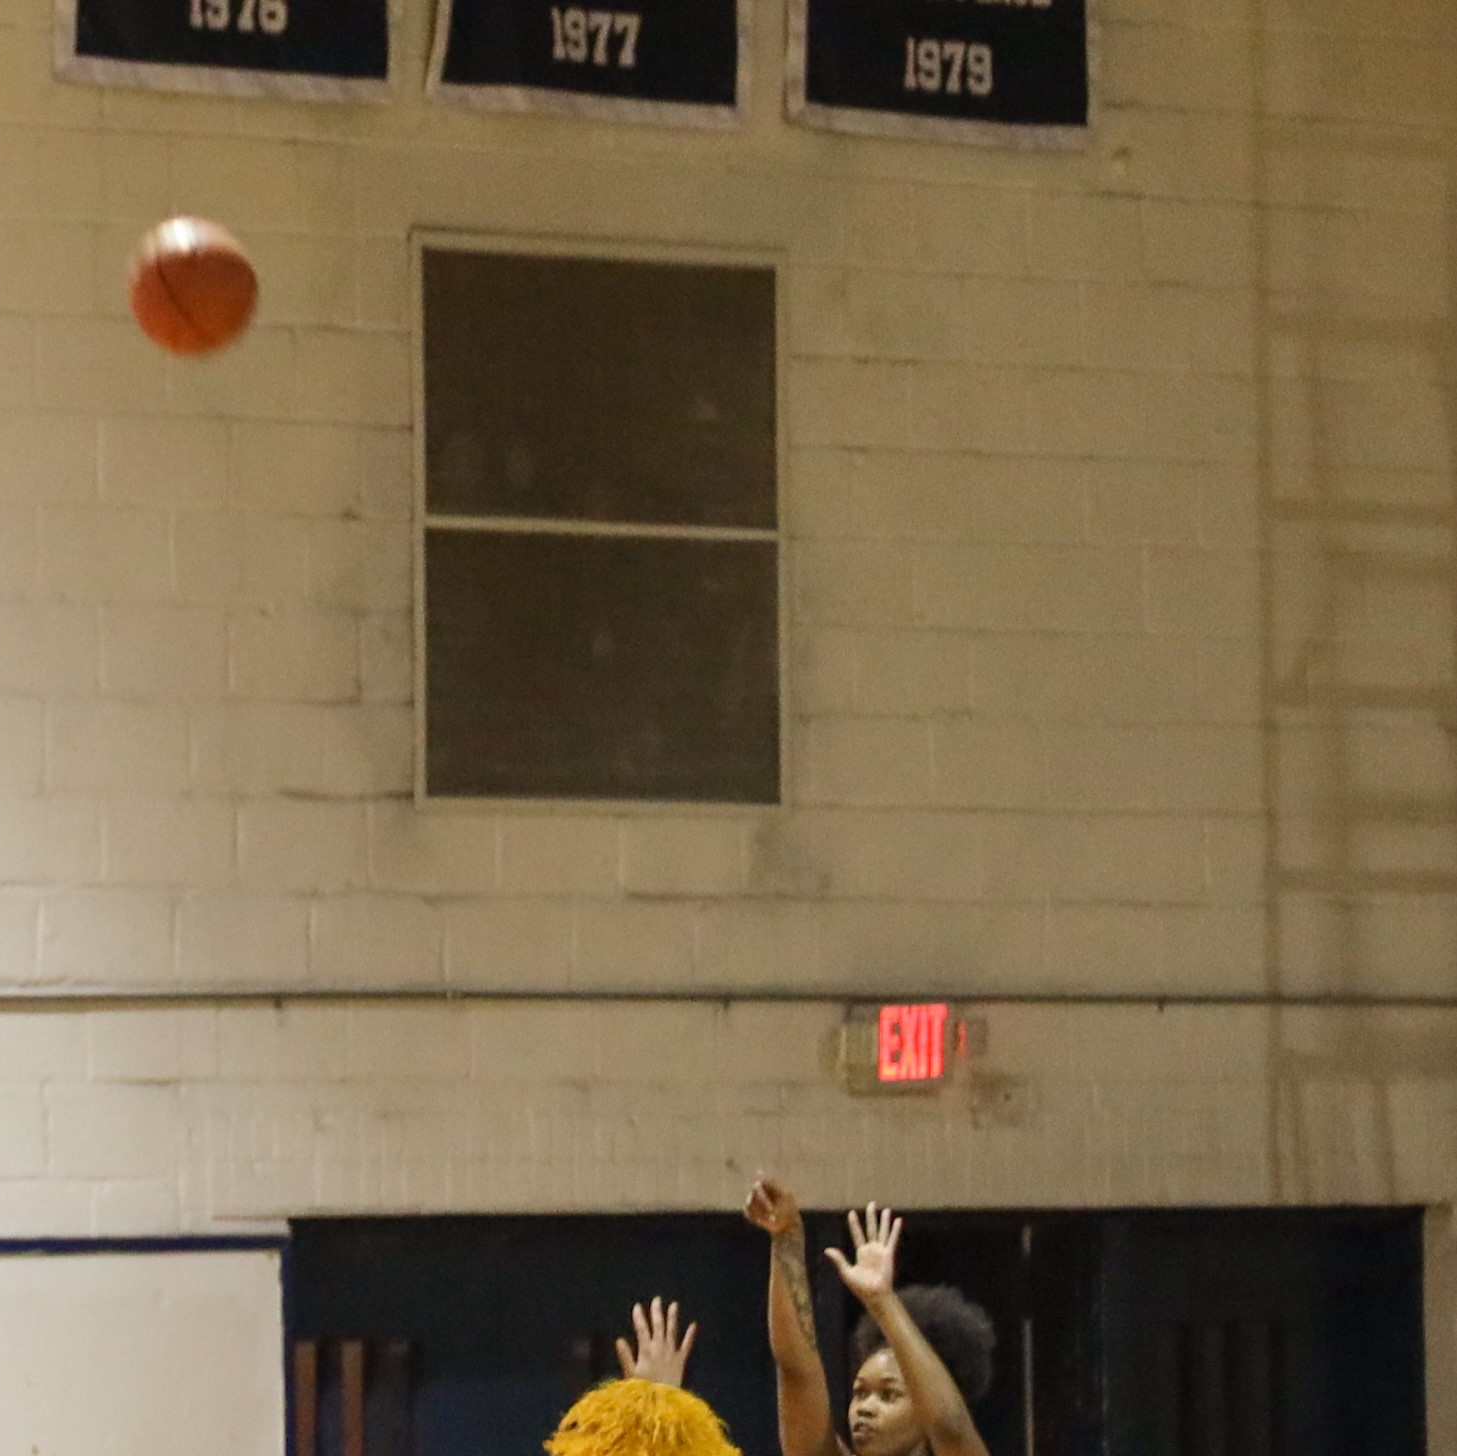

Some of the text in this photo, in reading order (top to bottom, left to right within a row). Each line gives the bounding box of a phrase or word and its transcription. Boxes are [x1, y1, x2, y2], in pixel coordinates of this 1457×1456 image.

[550, 6, 641, 68] 1977
[903, 36, 993, 96] 1979
[878, 1003, 949, 1081] EXIT
